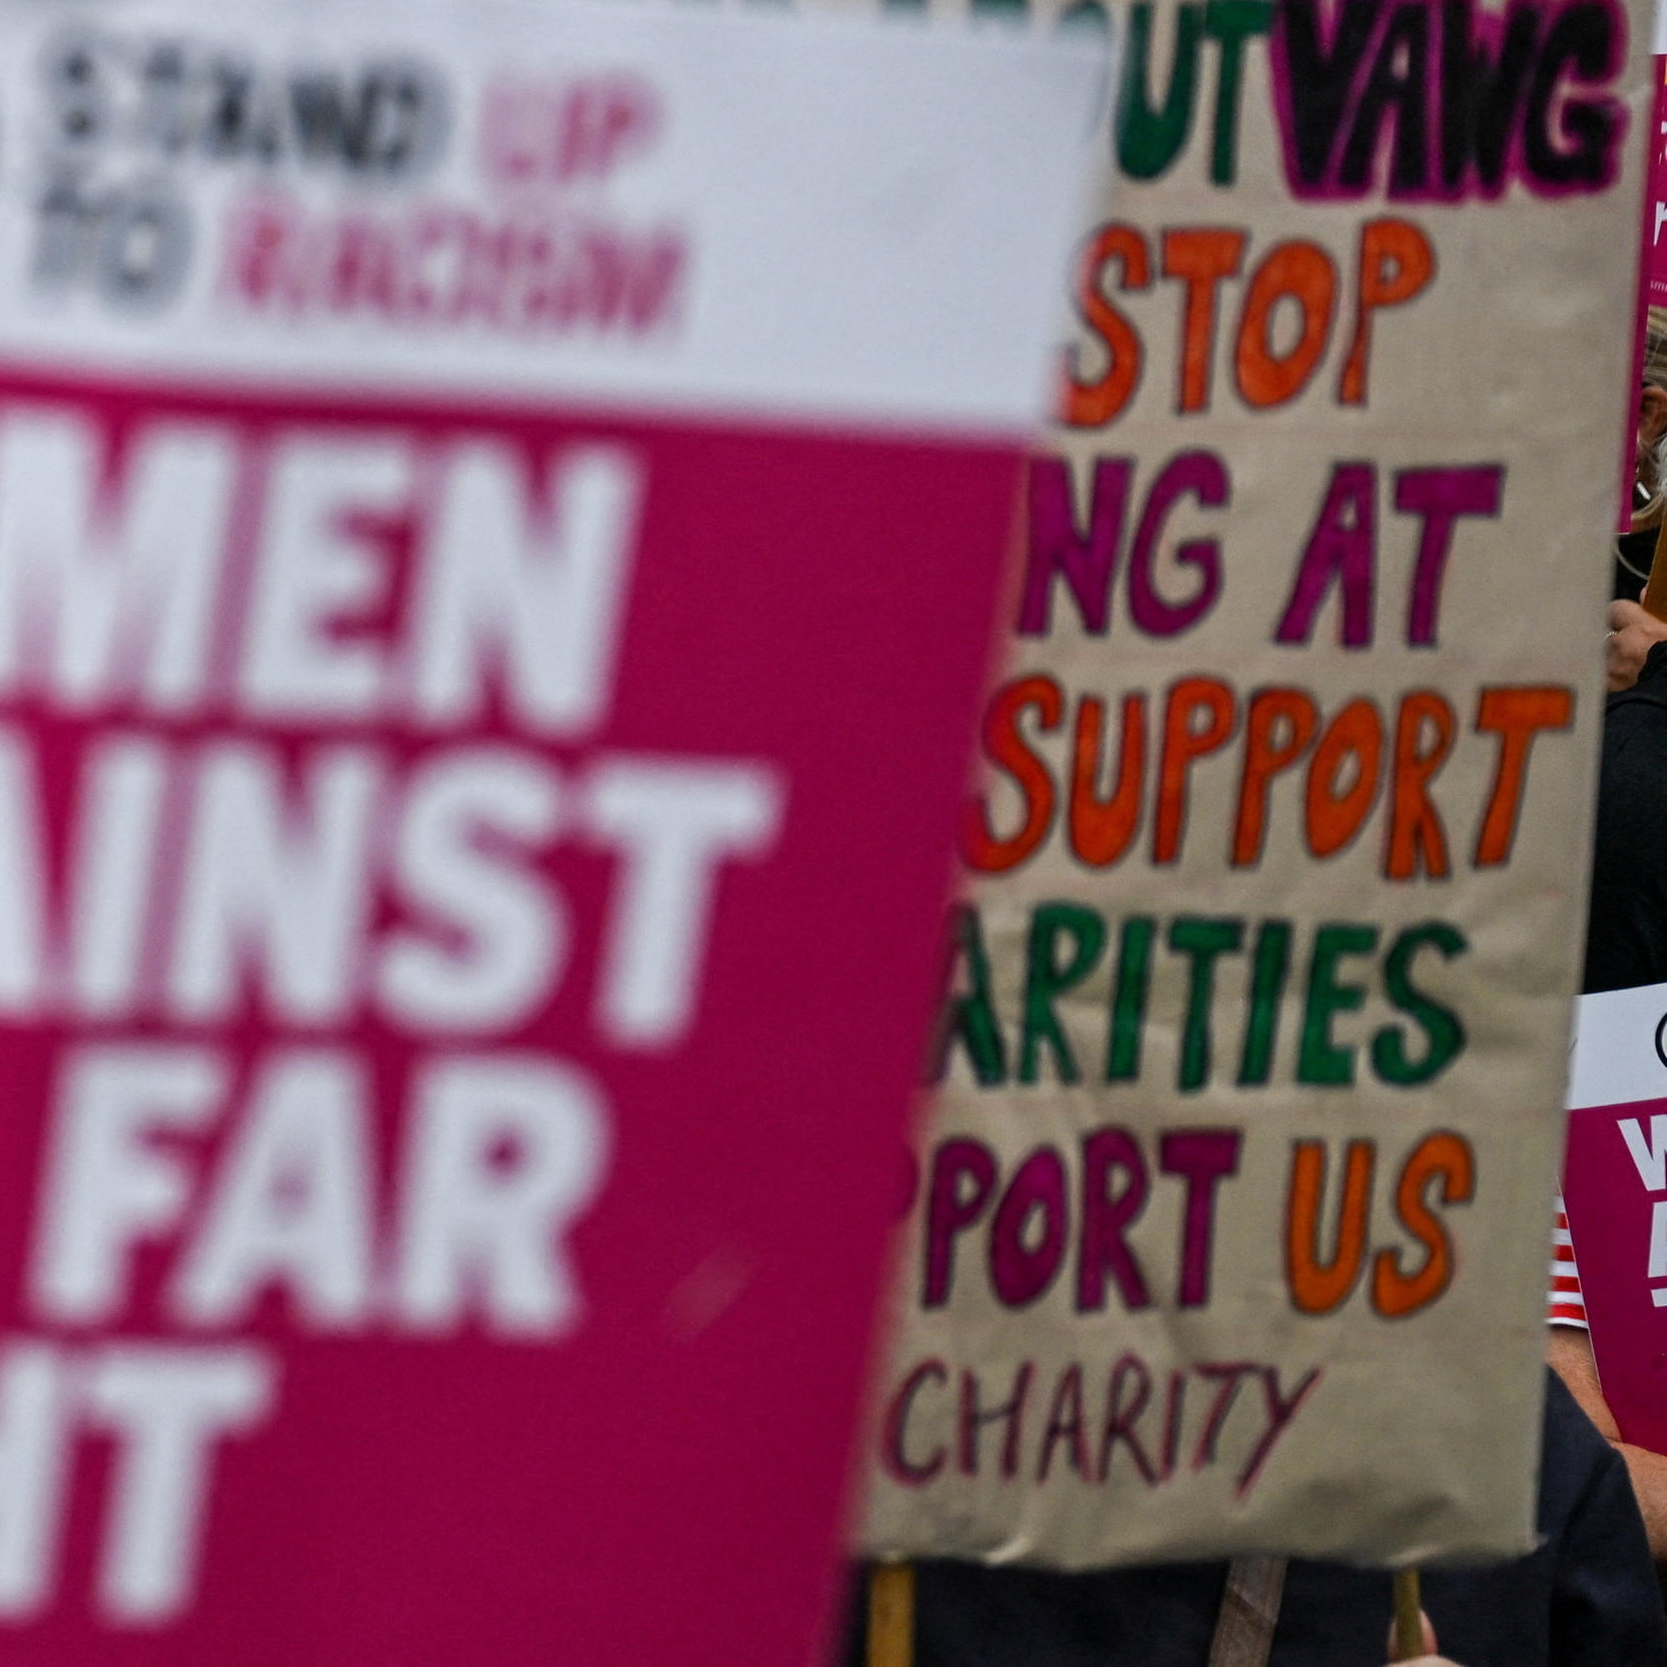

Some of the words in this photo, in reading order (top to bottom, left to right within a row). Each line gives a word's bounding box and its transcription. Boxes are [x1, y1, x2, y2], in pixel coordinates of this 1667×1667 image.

[33, 24, 447, 184] STAND
[475, 59, 667, 202] UP
[29, 159, 195, 314] TO
[217, 199, 693, 342] RACISM
[1056, 219, 1435, 428] STOP
[1274, 460, 1505, 650] AT
[960, 674, 1575, 882] SUPPORT
[29, 1036, 613, 1340] FAR
[1284, 1131, 1475, 1322] US
[879, 1352, 1327, 1504] CHARITY
